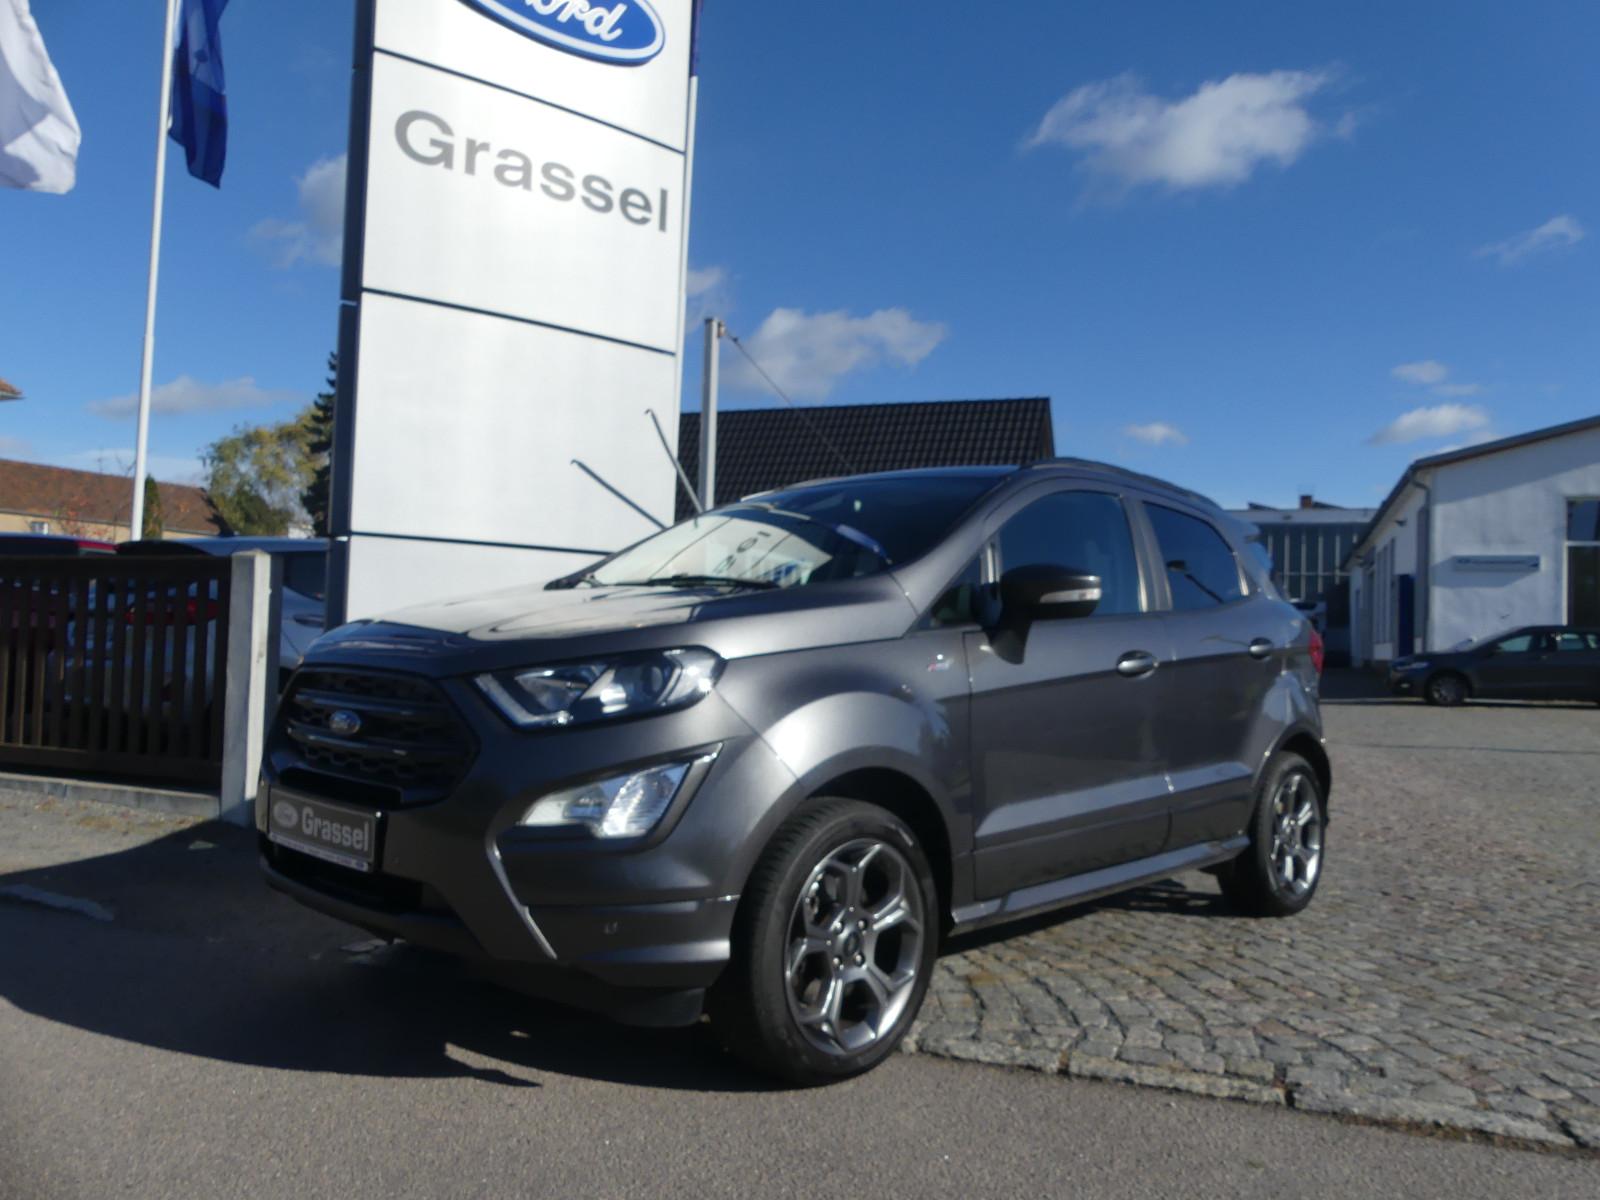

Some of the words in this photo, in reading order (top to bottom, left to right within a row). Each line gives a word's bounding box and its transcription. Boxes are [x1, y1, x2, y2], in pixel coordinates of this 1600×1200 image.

[525, 0, 628, 41] ord
[394, 109, 669, 233] Grassel
[302, 808, 369, 851] Grassel
